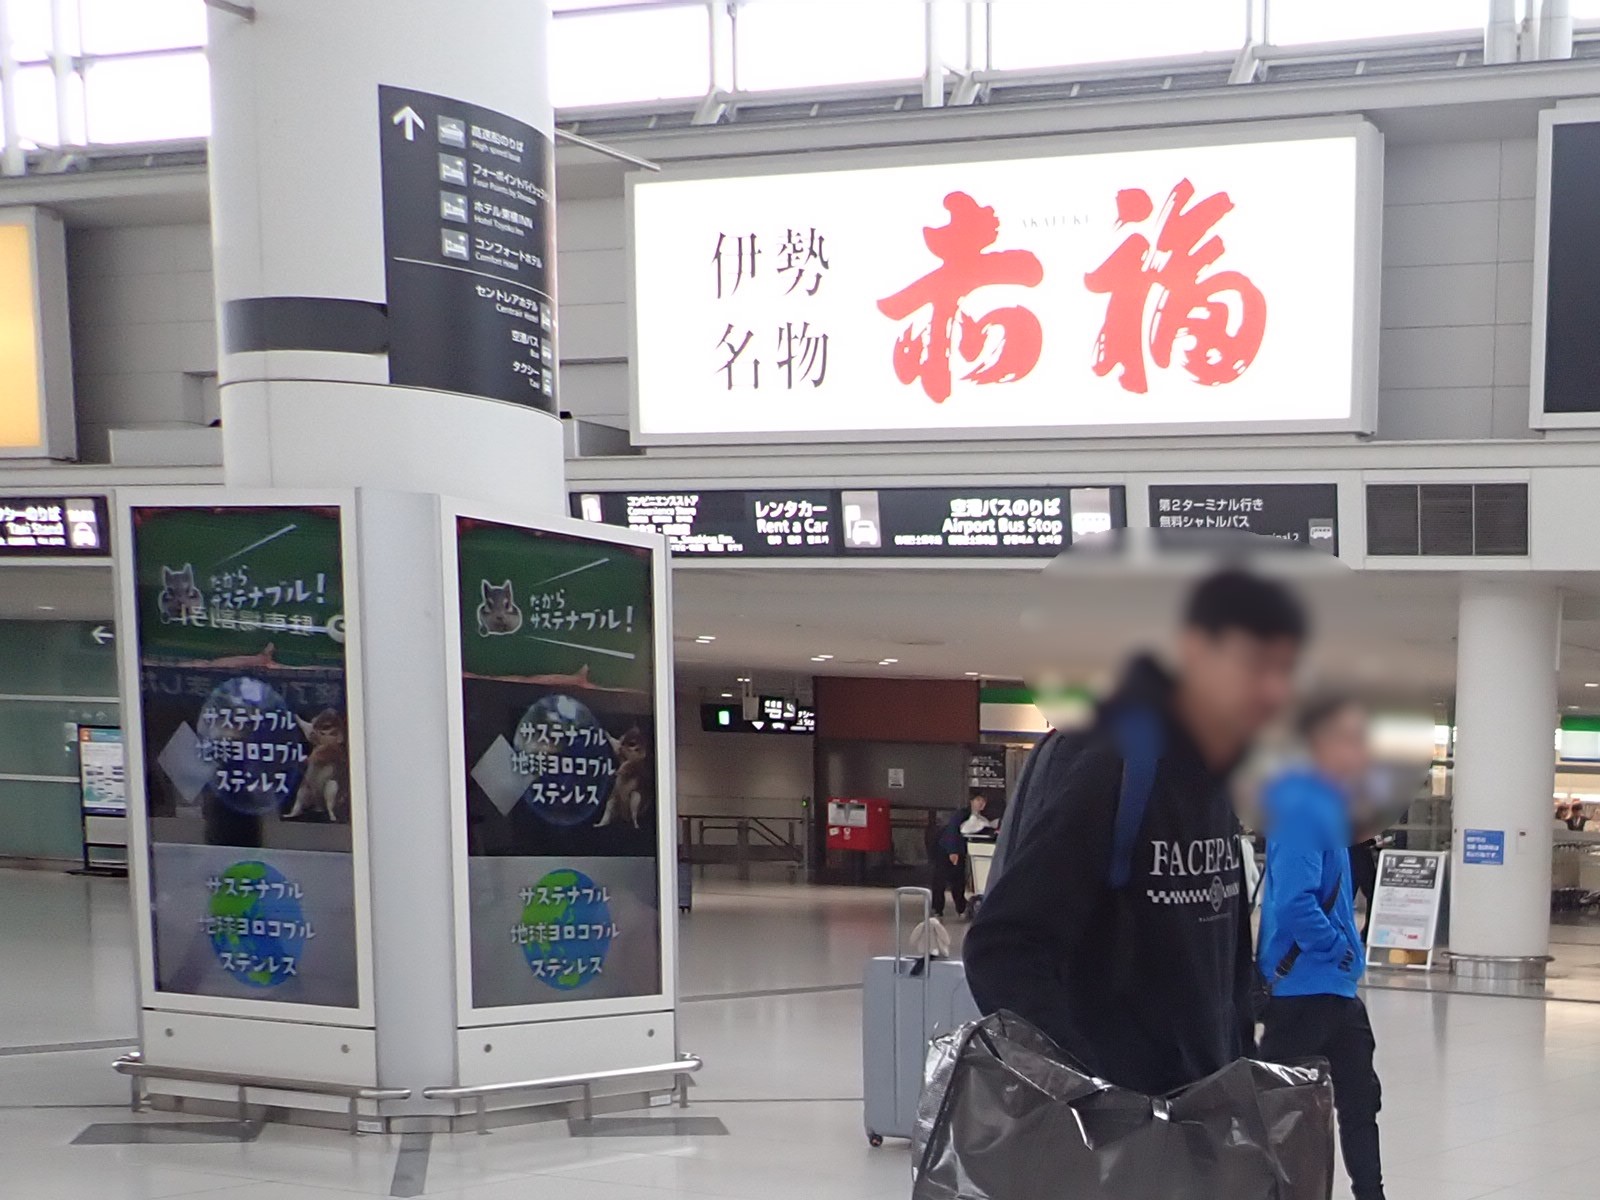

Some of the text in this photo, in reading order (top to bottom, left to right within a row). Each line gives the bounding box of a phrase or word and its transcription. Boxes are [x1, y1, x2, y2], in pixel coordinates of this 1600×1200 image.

[475, 238, 543, 268] コンフォートホテル
[711, 225, 831, 300] 伊勢
[475, 284, 539, 312] セントレアホテル
[715, 321, 830, 392] 名物
[513, 361, 540, 375] タクシー
[755, 500, 828, 518] レンタカー
[950, 498, 1061, 518] 空港バスのりば
[1159, 498, 1264, 512] 第2ターミナル行き
[756, 519, 829, 534] Rent a Car
[942, 517, 1063, 537] Airport Bus Stop
[1160, 515, 1250, 528] 無料シャトルバス
[530, 589, 565, 609] だから
[202, 708, 297, 731] サステナブル
[520, 722, 607, 748] サステナブル
[511, 750, 616, 778] 地球ヨロコブル
[216, 770, 289, 794] ステンレス
[532, 783, 600, 806] ステンレス
[206, 877, 304, 899] サステナブル
[519, 886, 612, 905] サステナブル
[510, 922, 620, 944] 地球ヨロコブル
[220, 953, 297, 975] ステンレス
[531, 957, 602, 977] ステンレス
